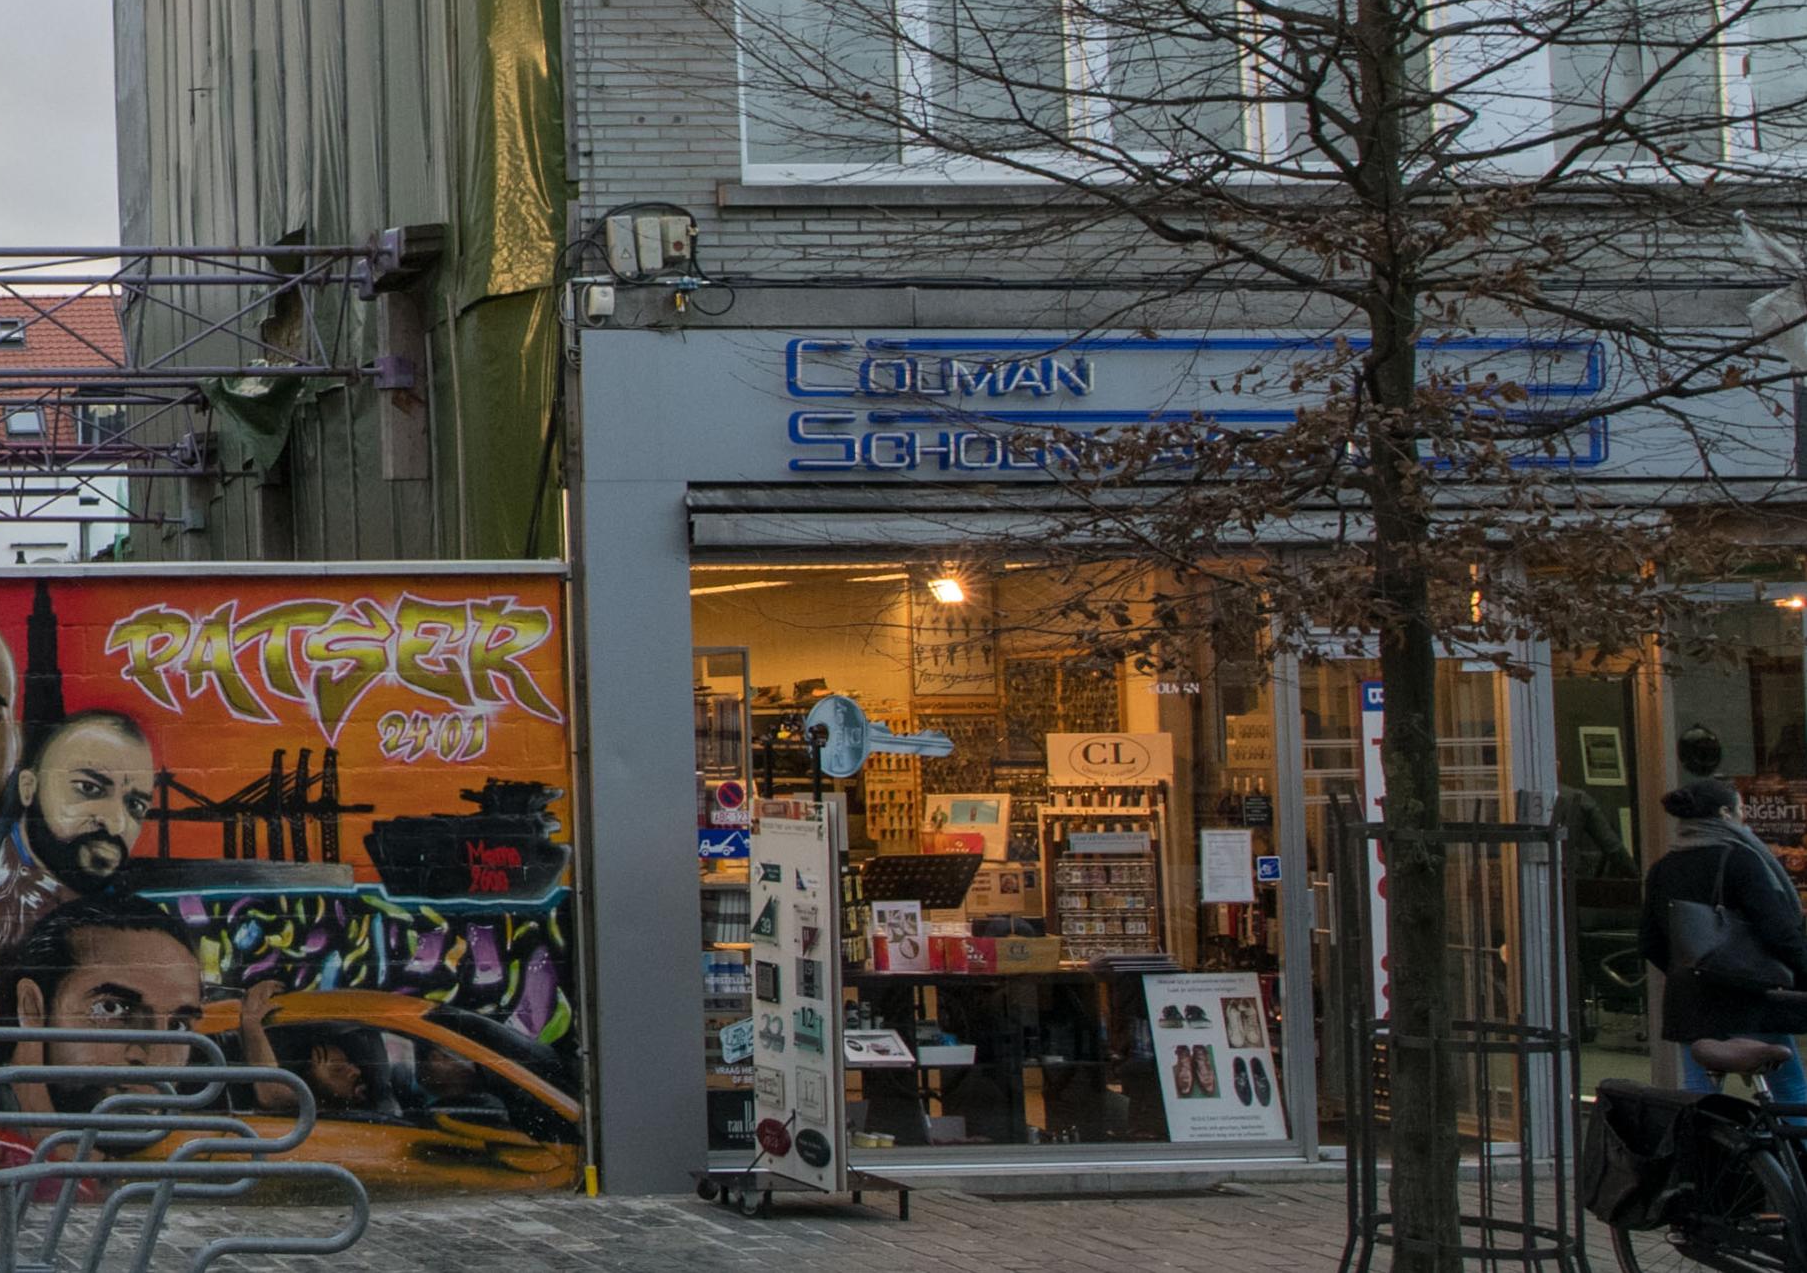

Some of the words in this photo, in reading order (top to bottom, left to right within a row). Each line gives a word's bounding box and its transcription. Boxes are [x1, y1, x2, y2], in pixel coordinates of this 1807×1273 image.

[786, 337, 1095, 399] COLMAN
[105, 591, 564, 748] PATSER
[1082, 741, 1136, 766] CL
